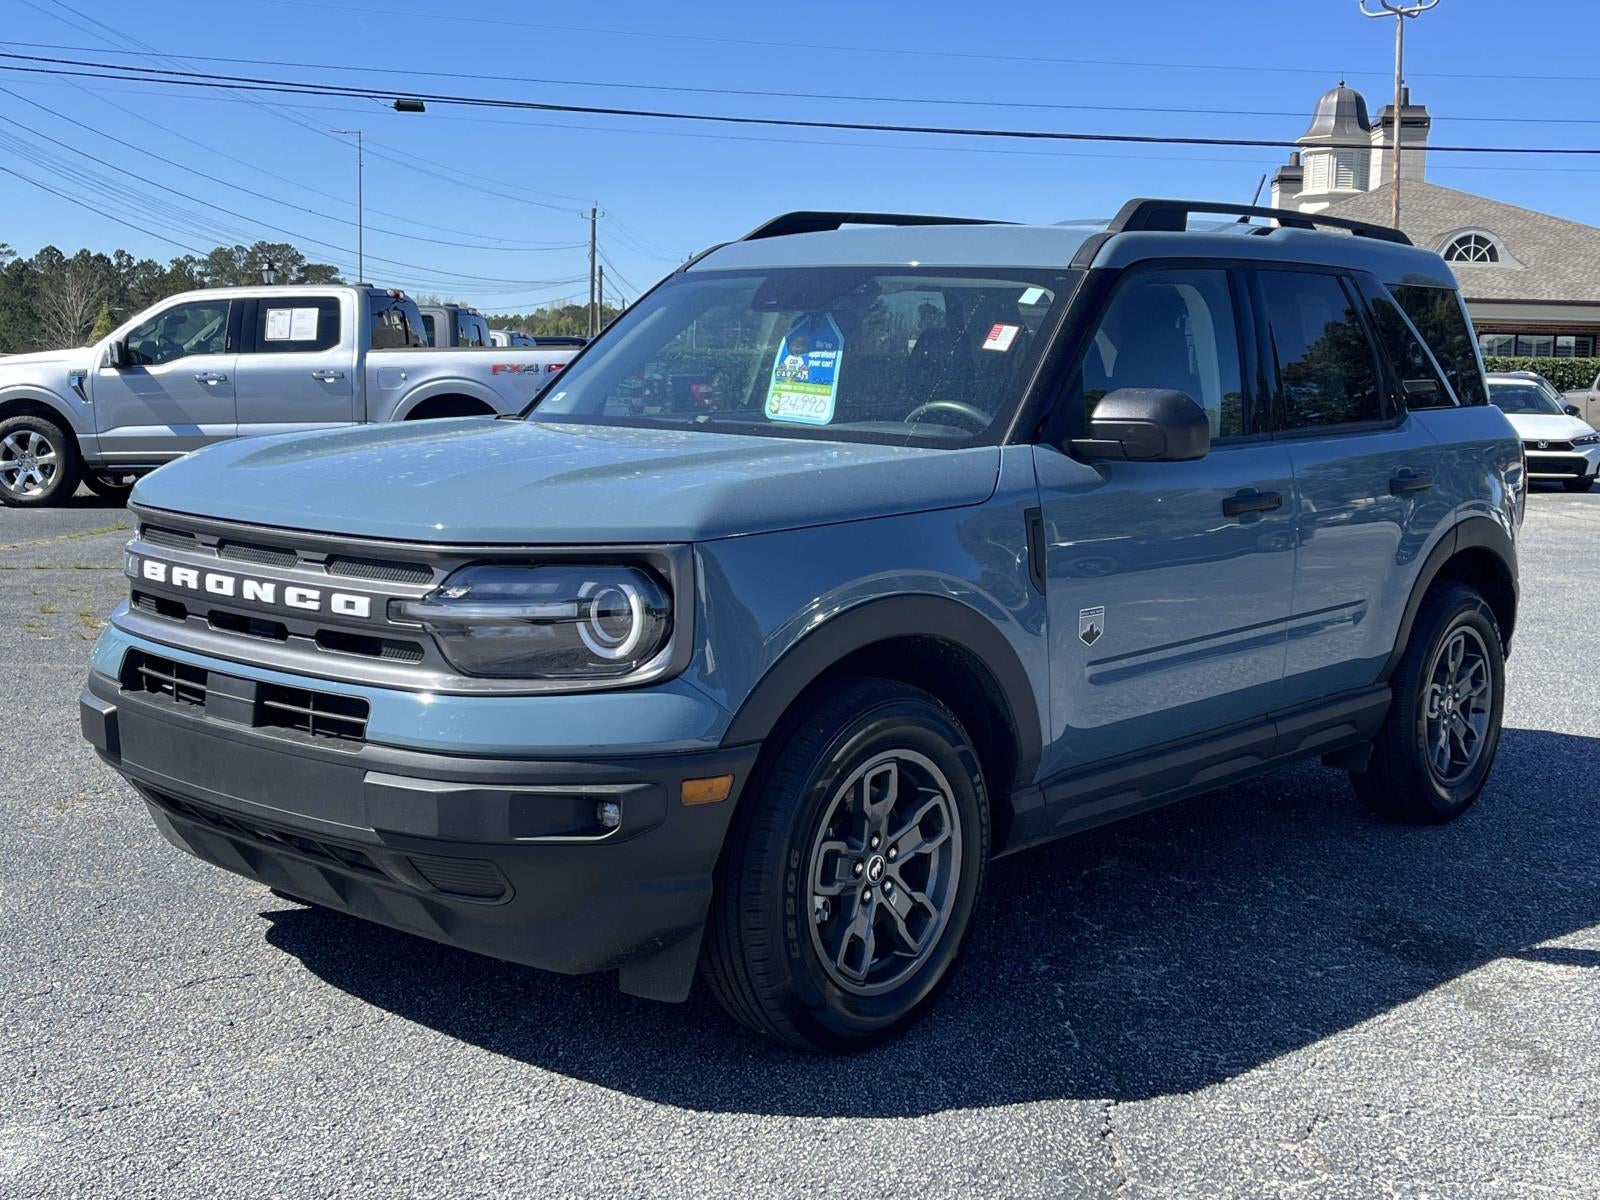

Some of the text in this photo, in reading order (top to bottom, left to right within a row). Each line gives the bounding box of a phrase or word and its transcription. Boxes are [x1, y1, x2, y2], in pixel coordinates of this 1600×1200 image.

[808, 350, 836, 359] appraised
[808, 359, 820, 367] your
[491, 363, 540, 376] FX4
[143, 559, 371, 618] BRONCO
